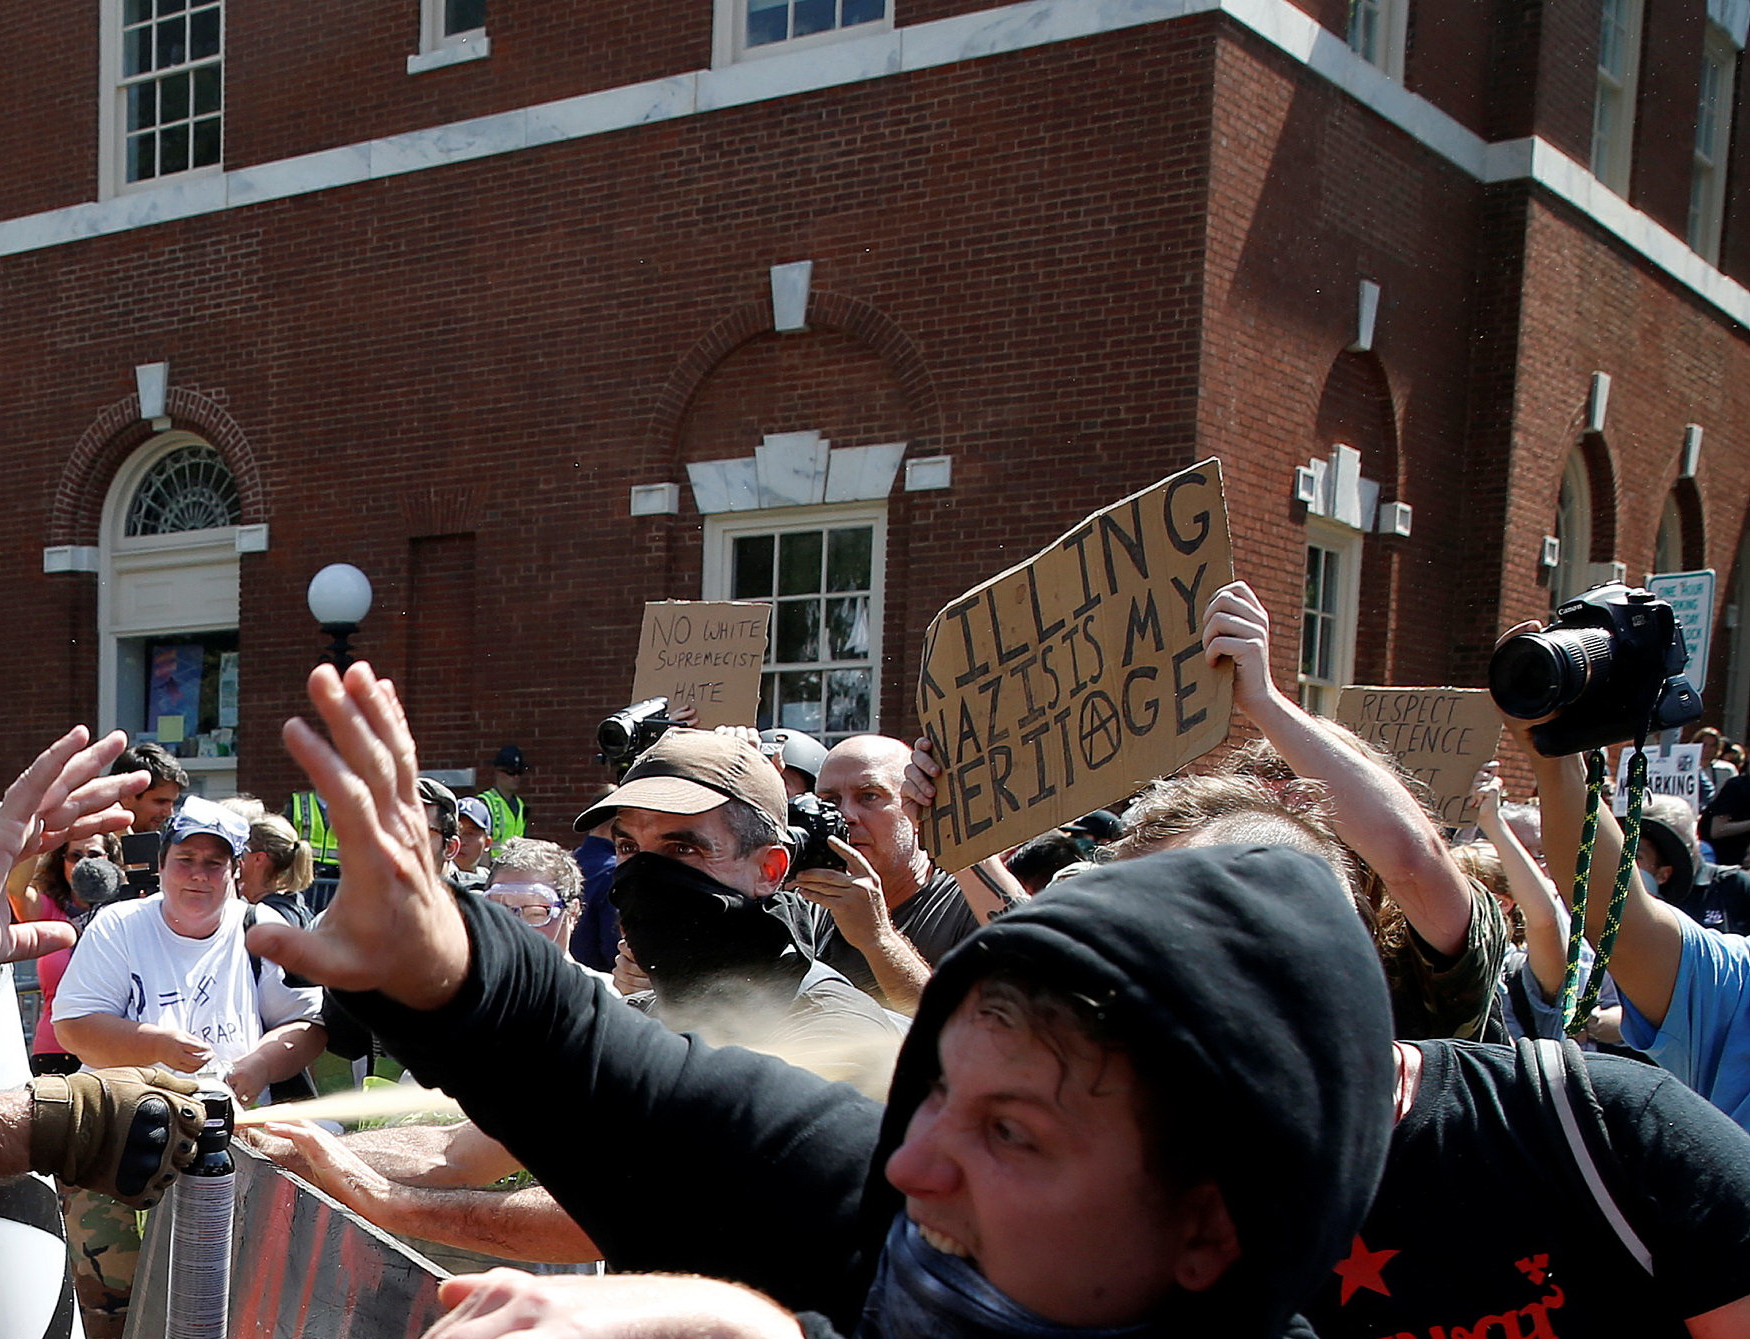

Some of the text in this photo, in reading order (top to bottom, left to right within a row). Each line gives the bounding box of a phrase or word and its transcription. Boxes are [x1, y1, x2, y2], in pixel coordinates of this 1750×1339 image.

[919, 472, 1211, 713] KILLING
[1558, 604, 1583, 615] Canon
[650, 614, 764, 649] NO WHITE
[654, 650, 761, 671] SUPREMECIST
[925, 562, 1207, 769] NAZIS IS MY
[673, 681, 725, 704] HATE
[1361, 694, 1464, 724] RESPECT
[1350, 721, 1475, 756] XISTENCE
